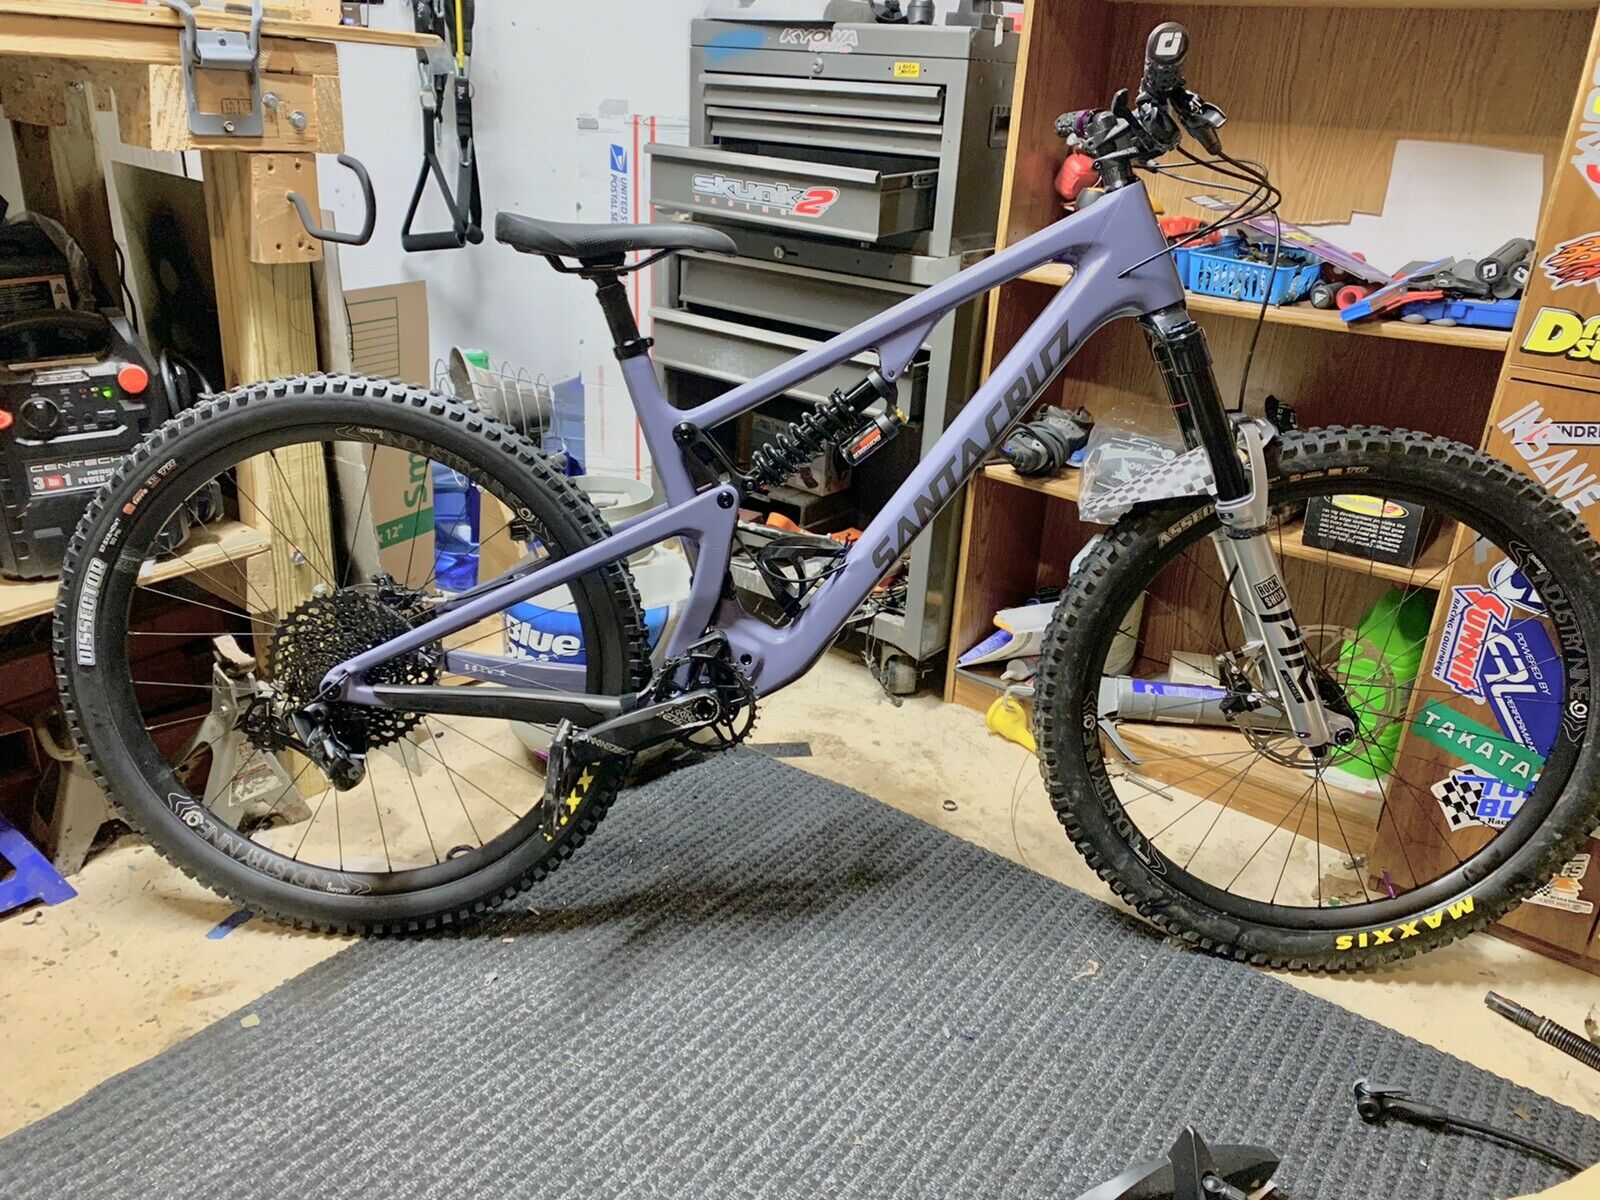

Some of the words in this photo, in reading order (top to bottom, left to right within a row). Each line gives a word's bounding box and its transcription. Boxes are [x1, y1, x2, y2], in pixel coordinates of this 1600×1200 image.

[779, 28, 859, 47] KYOWA
[610, 174, 618, 209] POSTAL
[620, 178, 628, 214] UNITED
[872, 438, 988, 569] SANTA
[985, 319, 1069, 443] CRUZ
[1498, 400, 1600, 514] INSANE
[33, 477, 45, 490] 3
[63, 473, 72, 486] 1
[78, 476, 105, 485] POWER
[403, 453, 427, 508] Sm
[1257, 578, 1279, 597] ROCK
[1264, 588, 1286, 609] SHOX
[77, 557, 108, 666] DISSECTOR
[1448, 598, 1460, 629] RACING
[506, 613, 581, 657] Blue
[1435, 630, 1451, 677] EQUIPMENT
[1515, 632, 1542, 680] POWERED
[1538, 682, 1551, 696] BY
[1504, 695, 1538, 753] PERFORMANC
[1426, 711, 1530, 779] TAKATA
[1476, 798, 1518, 819] BL
[1488, 817, 1508, 825] Rac
[1335, 895, 1475, 950] MAXXIS
